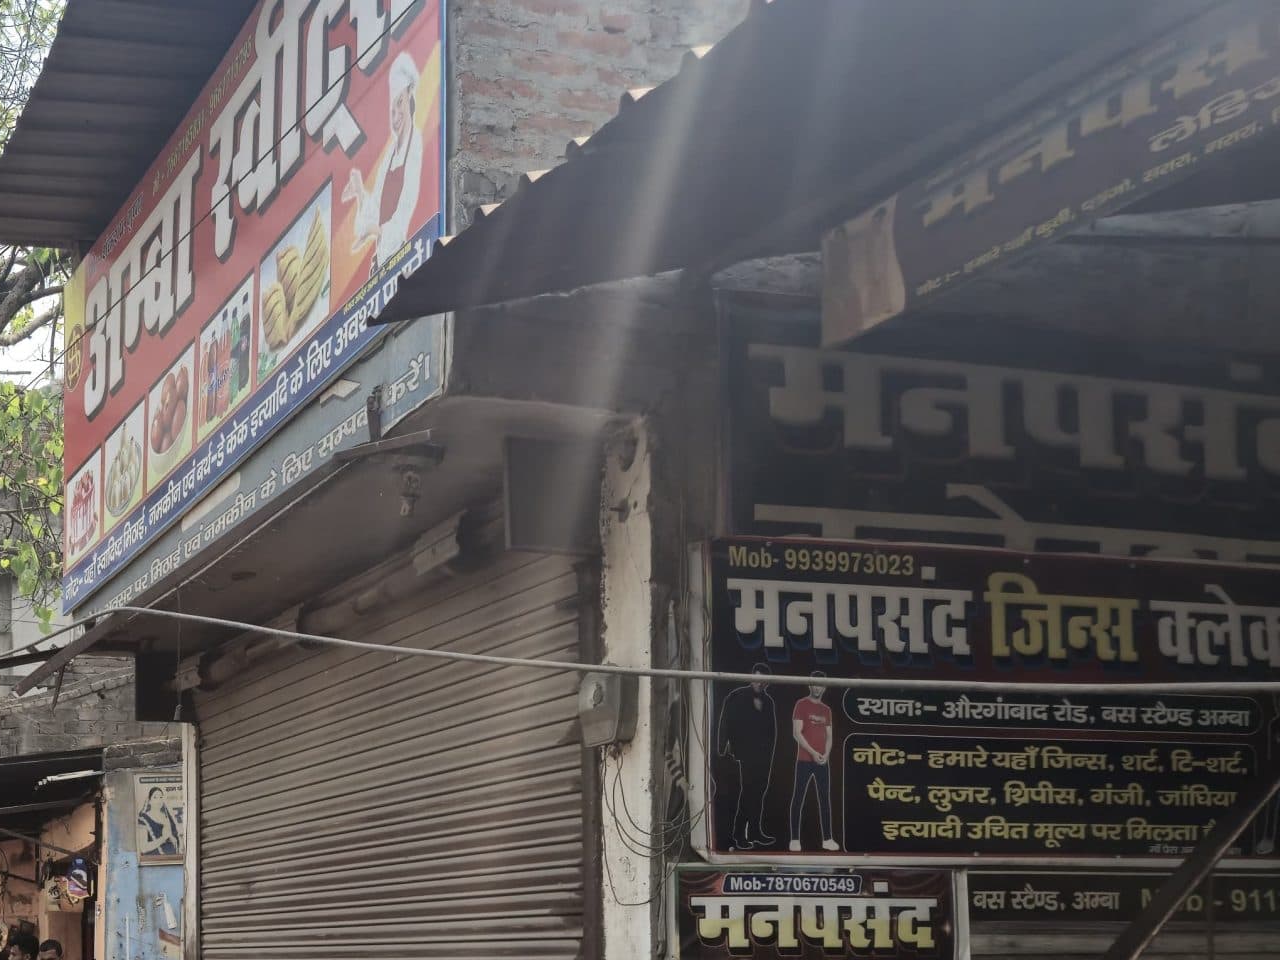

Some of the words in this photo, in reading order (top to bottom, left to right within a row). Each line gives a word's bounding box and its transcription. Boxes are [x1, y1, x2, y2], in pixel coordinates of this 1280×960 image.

[84, 145, 200, 418] अम्बा
[149, 479, 180, 526] नमकीन
[182, 459, 196, 499] एवं
[226, 414, 249, 455] केक
[250, 371, 289, 437] इत्यादि
[290, 355, 305, 395] के
[307, 337, 333, 383] लिए
[134, 572, 149, 593] पर
[150, 541, 181, 586] मिठाई
[184, 524, 205, 558] एवं
[204, 489, 257, 542] नमकीन
[260, 467, 280, 500] के
[281, 446, 315, 484] लिए
[728, 545, 778, 569] Mob-
[784, 548, 914, 576] 9939973023
[727, 566, 973, 656] मनपसंद
[983, 572, 1140, 662] जिन्स
[1101, 706, 1137, 723] बस
[1140, 701, 1196, 727] स्टैण्ड
[1197, 709, 1250, 727] अम्बा
[927, 745, 990, 769] हमारे
[992, 745, 1040, 771] यहाँ
[1156, 784, 1238, 807] जांघिया
[881, 814, 963, 840] इत्यादी
[967, 816, 1030, 840] उचित
[1033, 823, 1087, 848] मूल्य
[1091, 823, 1122, 840] पर
[1126, 817, 1200, 841] मिलता
[730, 876, 855, 893] Mob-7870670549
[690, 881, 937, 948] मनपसंद
[972, 890, 1006, 911] बस
[1071, 891, 1120, 912] अम्बा
